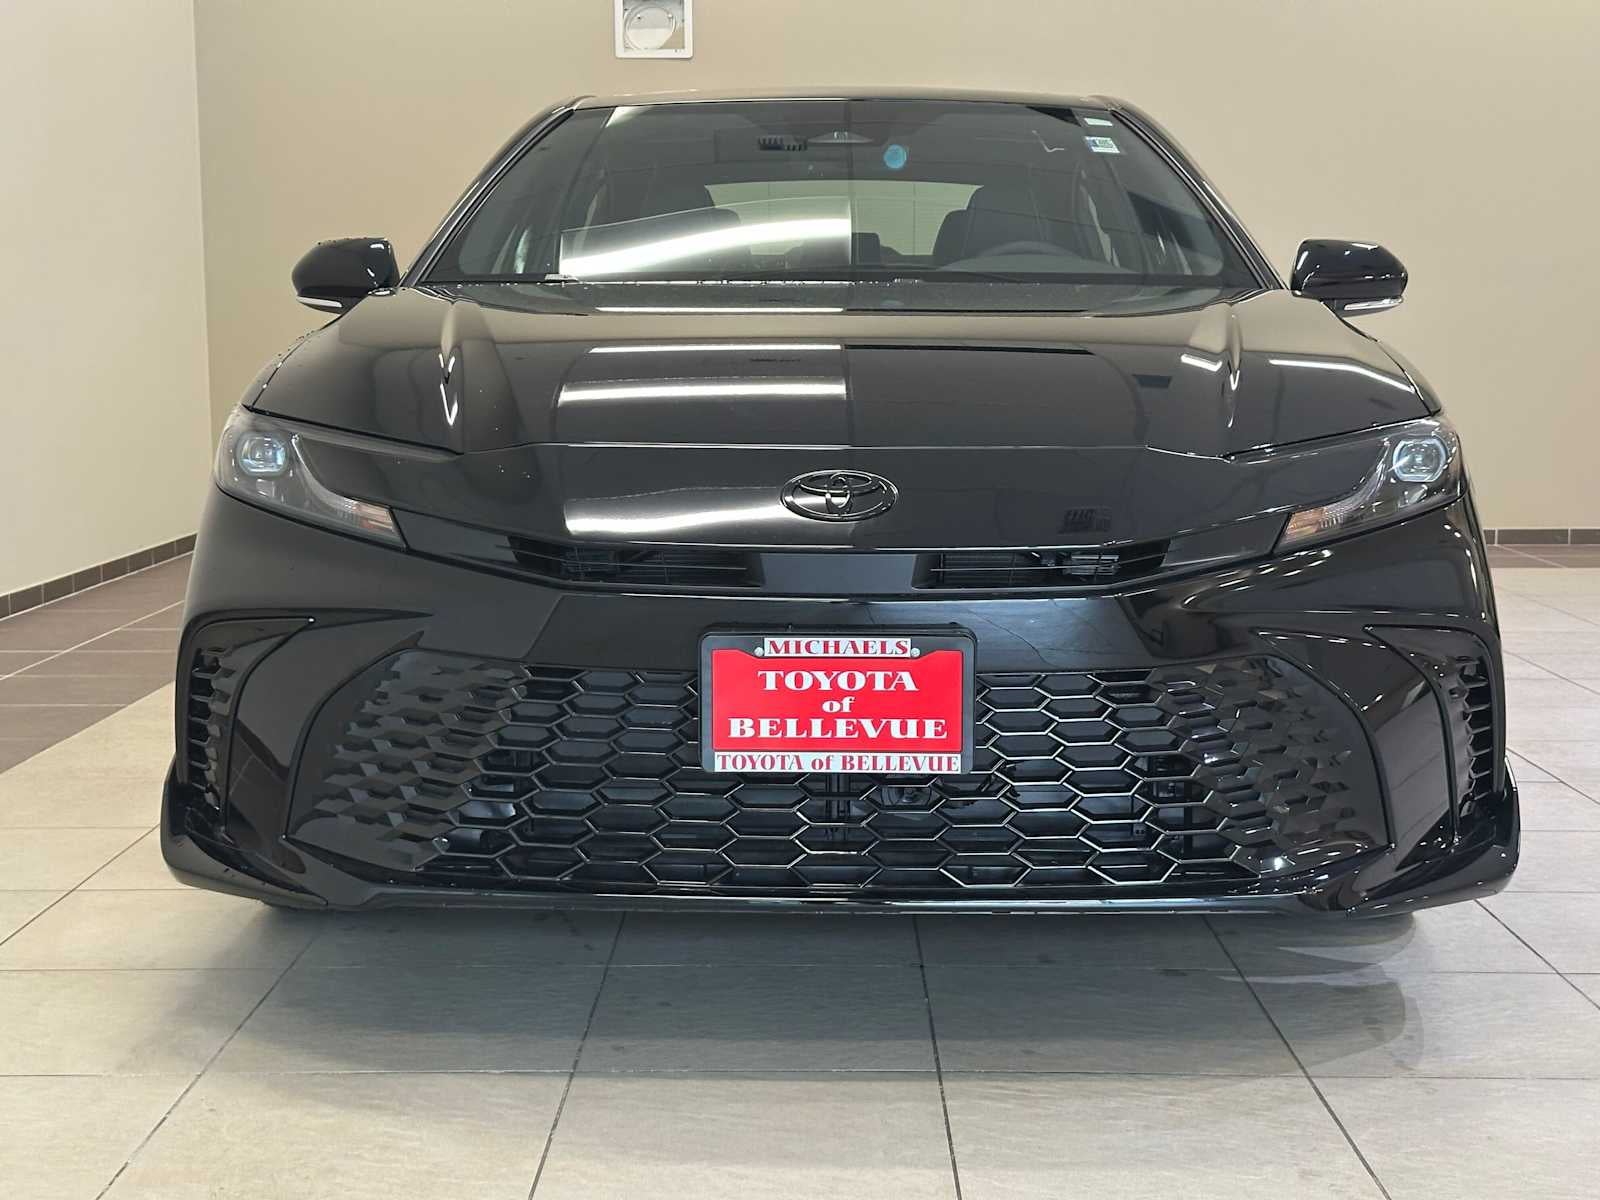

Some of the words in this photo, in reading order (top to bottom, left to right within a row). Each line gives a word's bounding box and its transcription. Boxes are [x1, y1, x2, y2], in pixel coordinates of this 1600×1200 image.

[768, 640, 909, 655] MICHAELS
[757, 670, 919, 691] TOYOTA
[822, 696, 855, 713] of
[728, 718, 948, 739] BELLEVUE
[716, 754, 804, 771] TOYOTA
[811, 755, 833, 771] of
[841, 755, 959, 772] BELLEVUE
